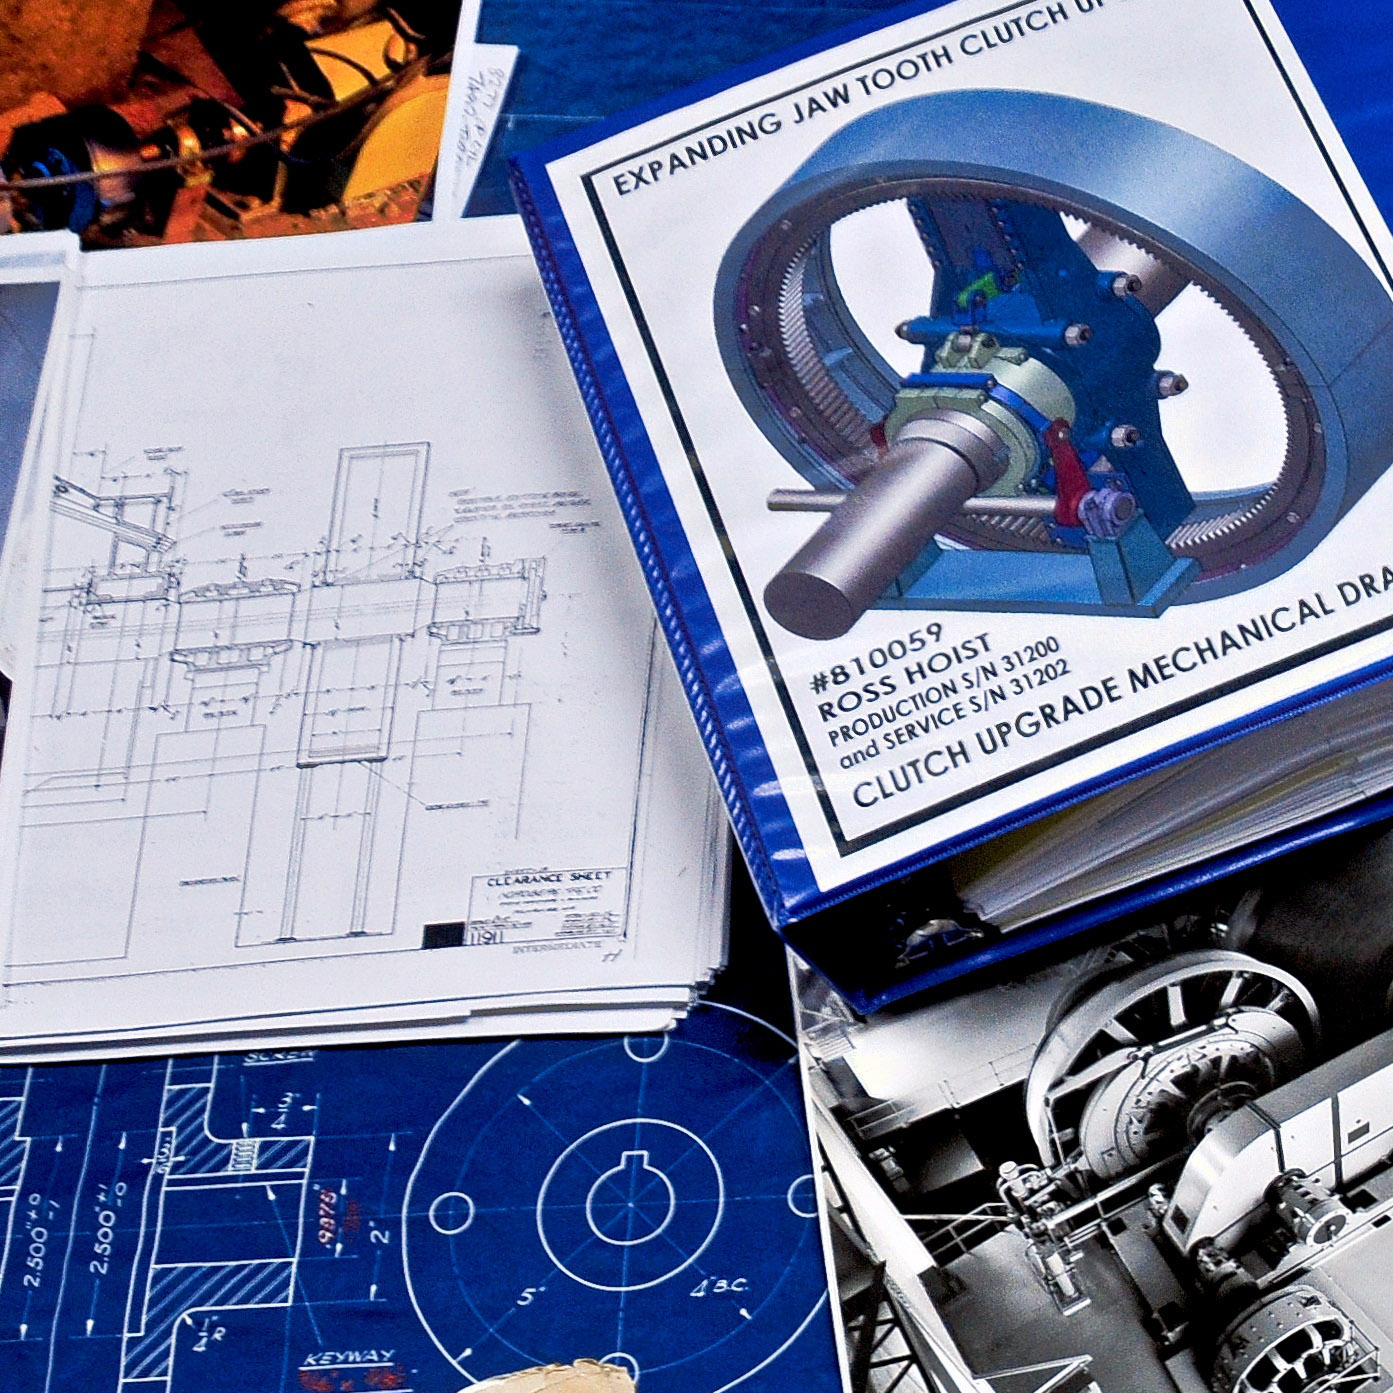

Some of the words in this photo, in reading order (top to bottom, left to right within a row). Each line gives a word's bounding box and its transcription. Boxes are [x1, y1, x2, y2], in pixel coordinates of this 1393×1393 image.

[613, 113, 782, 196] EXPANDING
[794, 83, 850, 124] JAW
[855, 45, 953, 96] TOOTH
[960, 2, 1069, 56] CLUTCH
[809, 622, 942, 695] #810059
[818, 675, 897, 722] ROSS
[904, 632, 991, 685] HOIST
[828, 679, 959, 747] PRODUCTION
[961, 661, 998, 690] S/N
[1001, 636, 1060, 672] 31200
[853, 740, 971, 808] CLUTCH
[975, 676, 1123, 755] UPGRADE
[1127, 593, 1335, 693] MECHANICAL
[840, 739, 880, 769] and
[883, 702, 967, 750] SERVICE
[969, 685, 1007, 713] S/N
[1010, 658, 1071, 696] 31202
[487, 873, 564, 887] CLEARANCE
[570, 871, 612, 881] SHEET
[303, 1348, 396, 1365] KEYWAY
